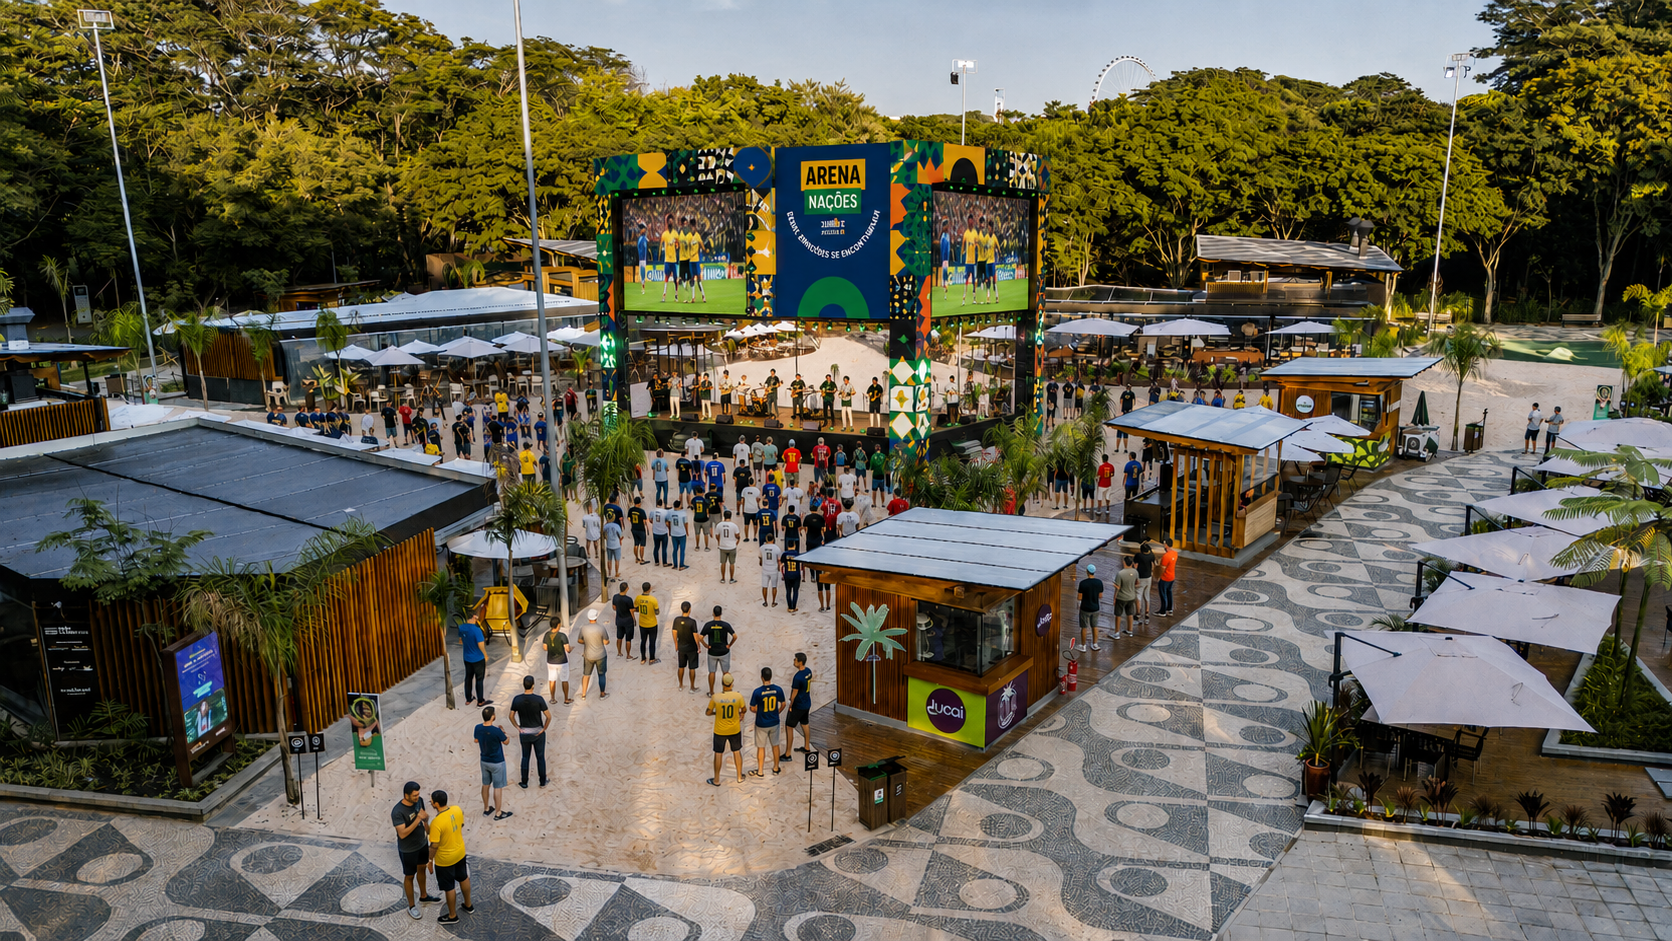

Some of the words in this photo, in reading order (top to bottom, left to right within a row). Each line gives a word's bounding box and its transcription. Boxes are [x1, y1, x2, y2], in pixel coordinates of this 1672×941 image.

[805, 164, 861, 186] ARENA
[721, 704, 734, 720] 10
[762, 695, 777, 713] 10
